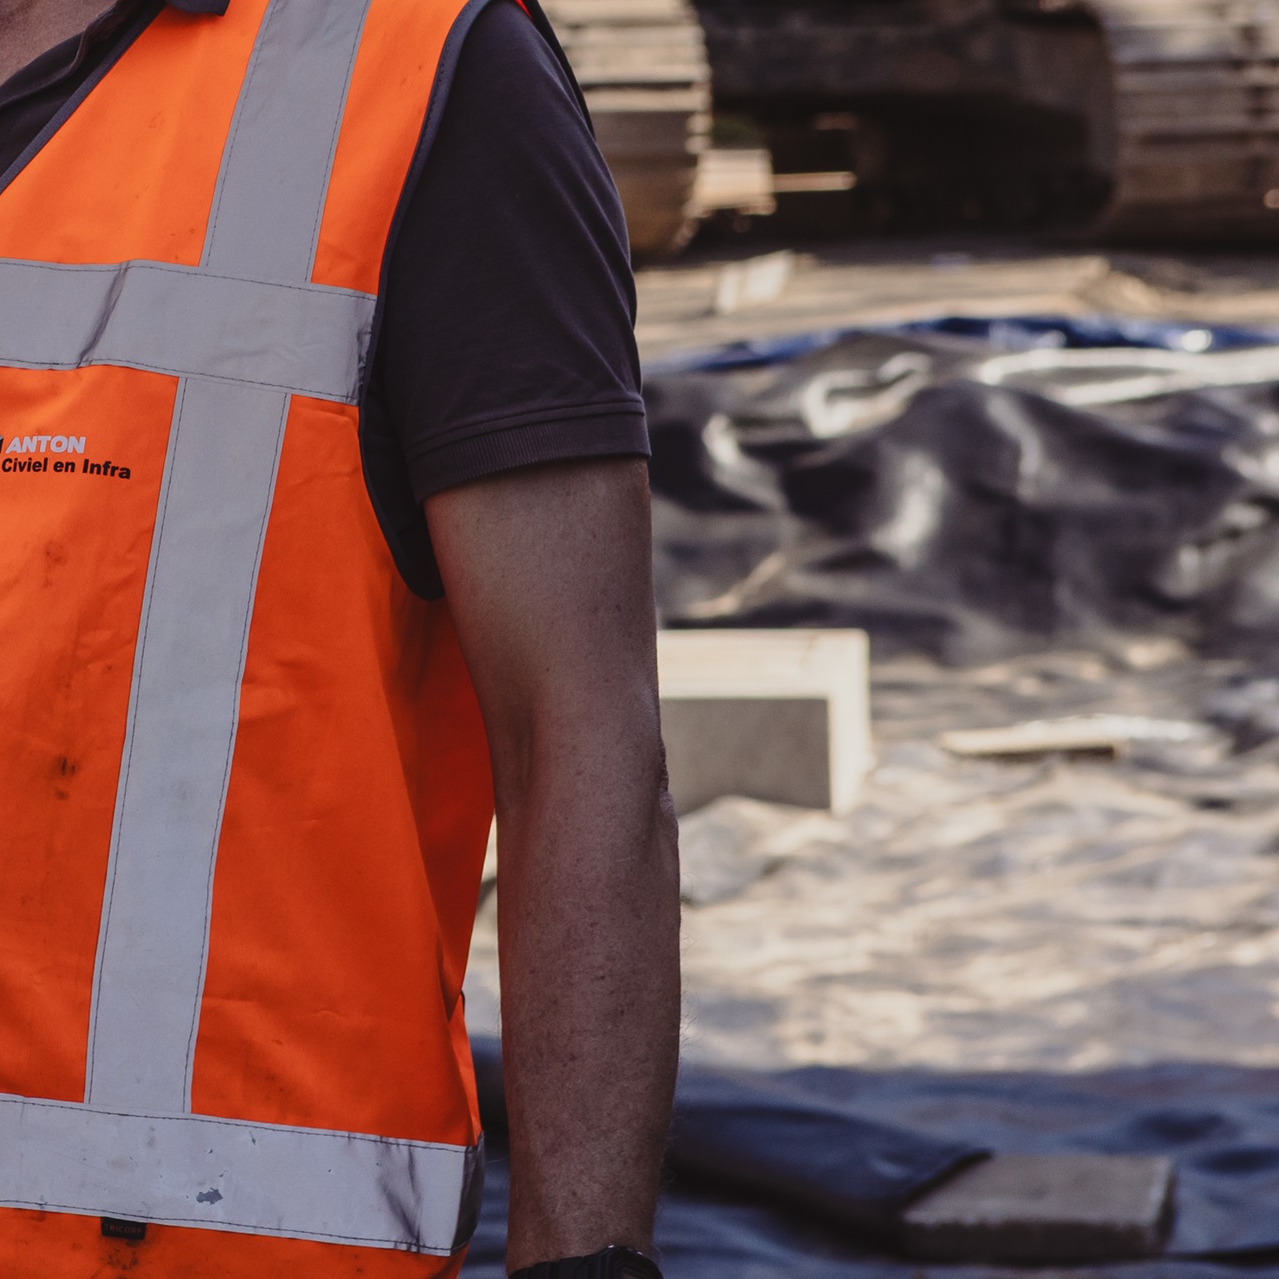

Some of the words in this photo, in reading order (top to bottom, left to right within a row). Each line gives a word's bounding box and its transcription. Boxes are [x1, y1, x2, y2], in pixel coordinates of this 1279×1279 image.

[5, 435, 86, 454] ANTON
[1, 457, 49, 473] Civiel
[53, 461, 76, 473] en
[82, 459, 131, 480] Infra
